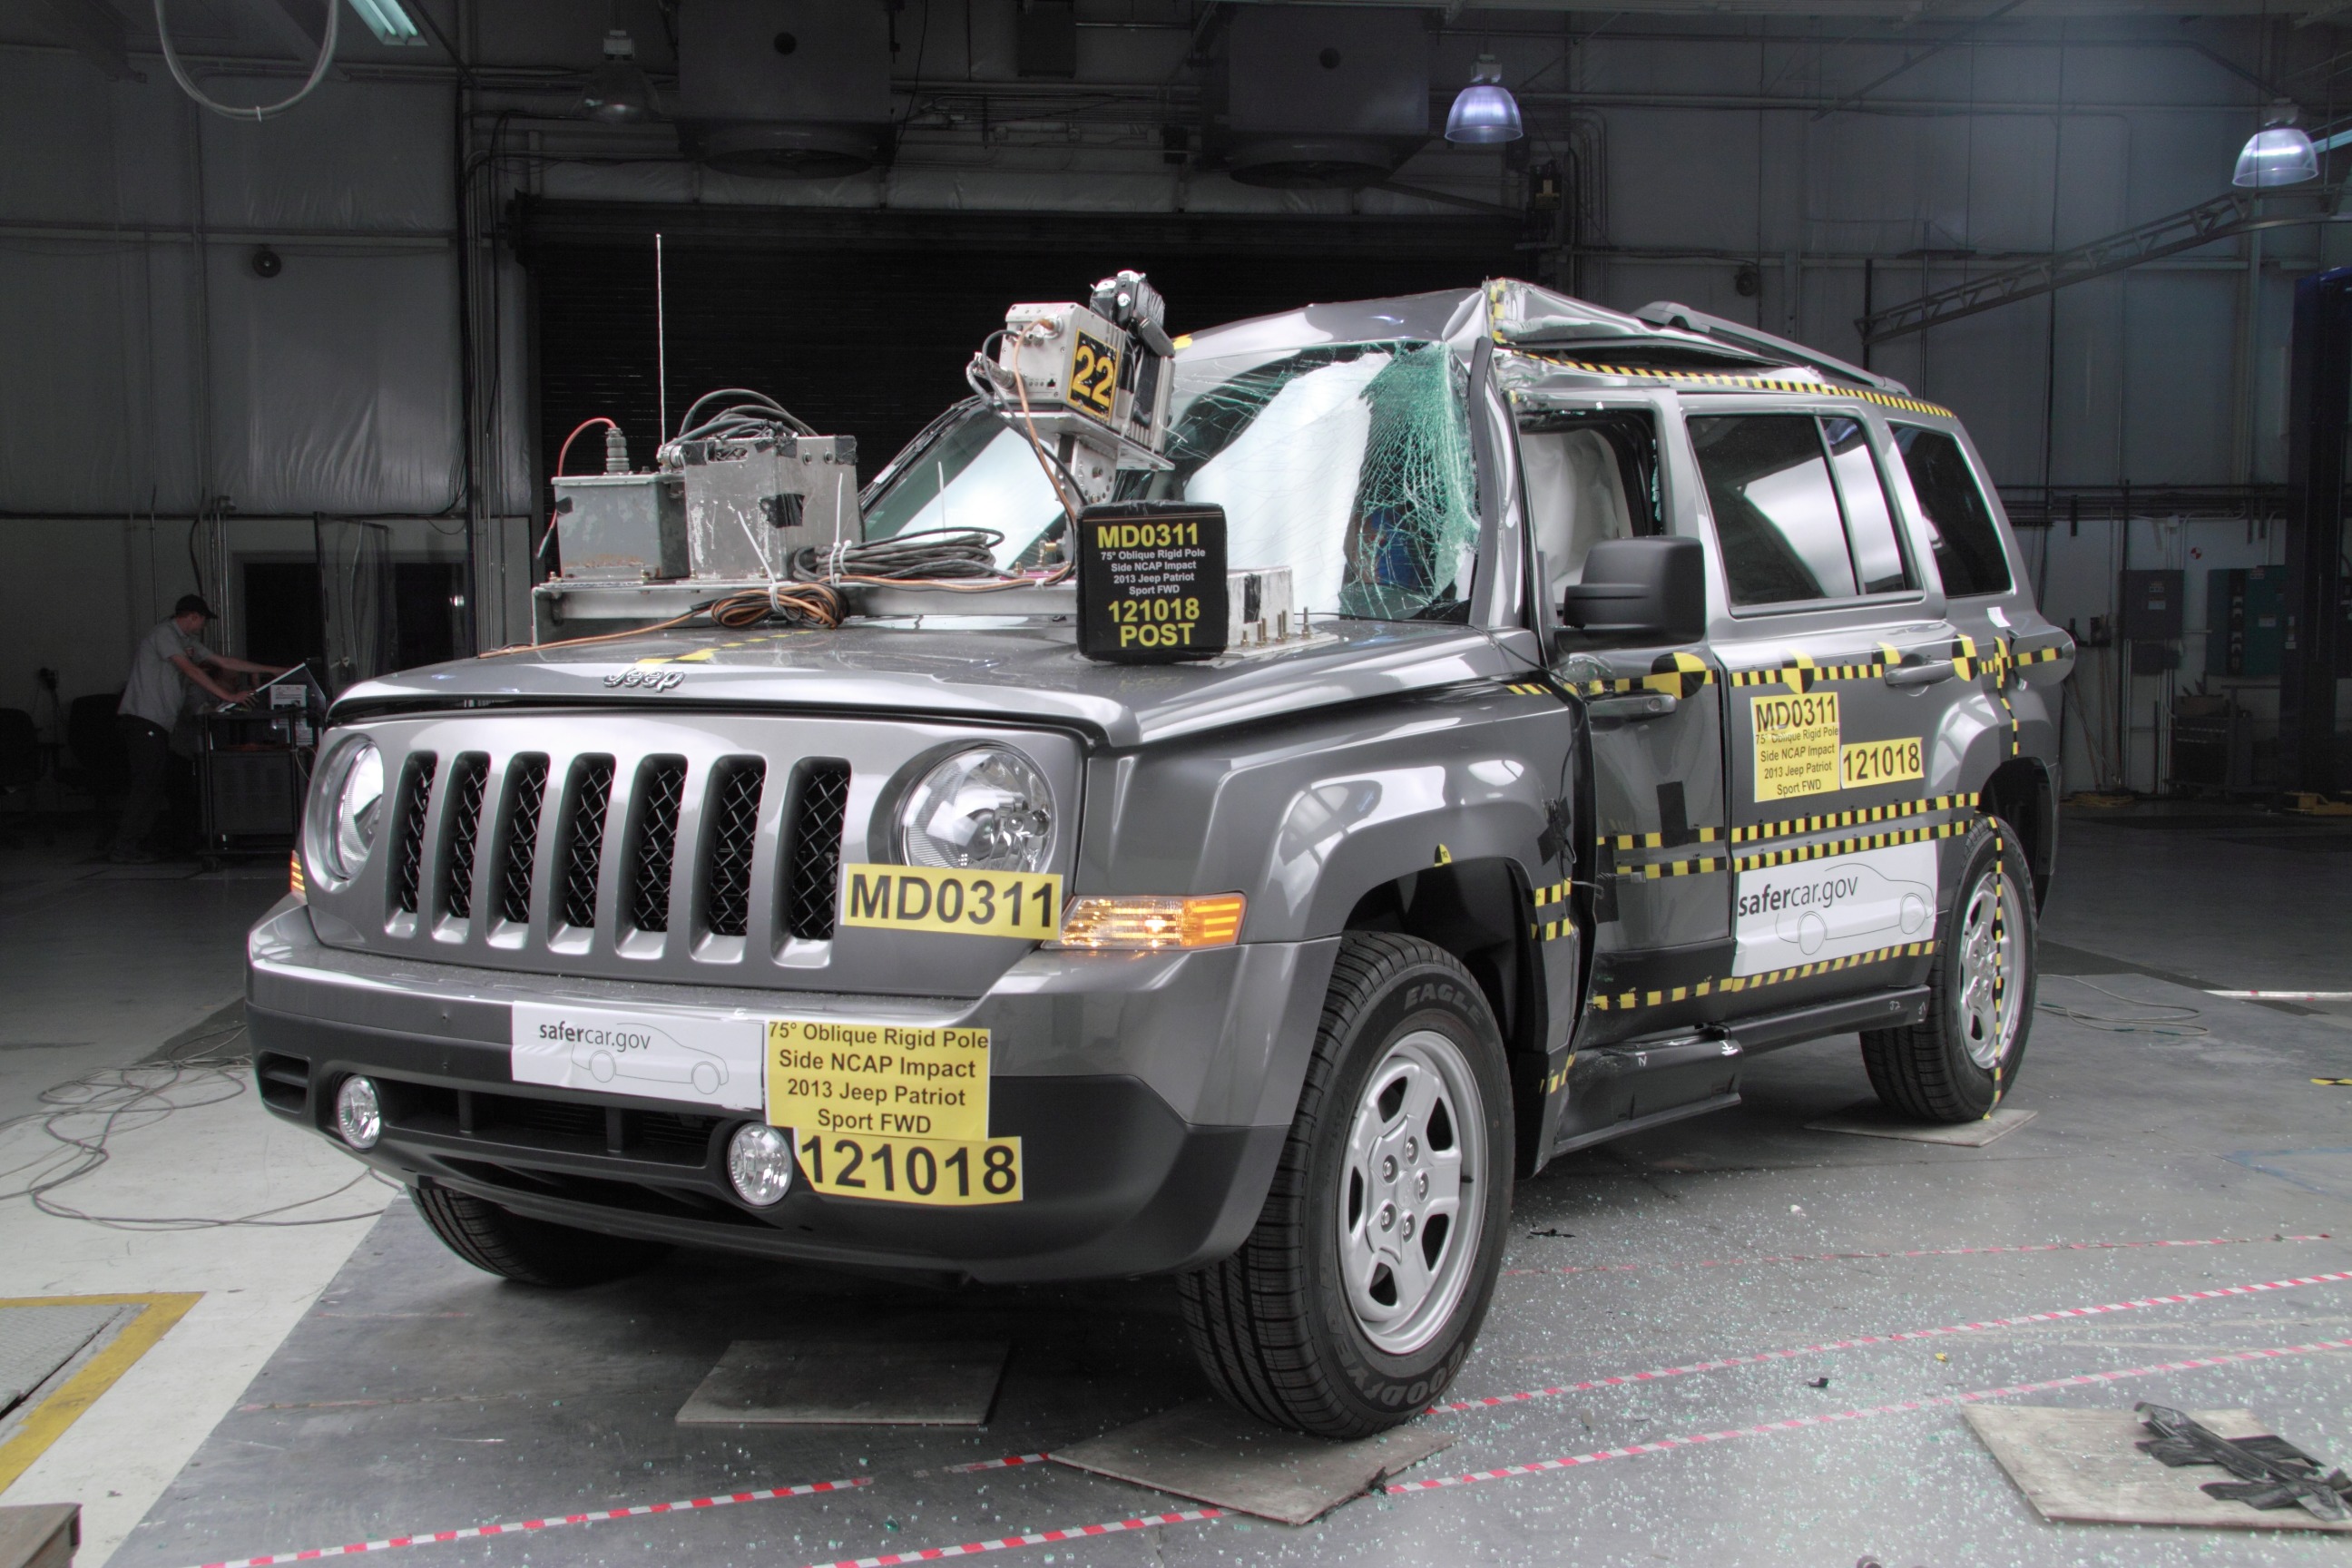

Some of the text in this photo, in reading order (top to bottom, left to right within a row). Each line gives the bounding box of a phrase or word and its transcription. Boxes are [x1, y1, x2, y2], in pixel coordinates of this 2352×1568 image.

[1073, 345, 1114, 407] 22
[1097, 523, 1198, 548] MD0311
[1101, 548, 1206, 561] 75° Oblique Rigid Pole
[1111, 561, 1196, 573] Side NCAP Impact
[1113, 573, 1194, 585] 2013 Jeep Patriot
[1129, 584, 1180, 597] Sport FWD
[1108, 598, 1200, 622] 121018
[1120, 622, 1195, 647] POST
[603, 665, 685, 692] Jeep
[1756, 695, 1835, 732] MD0311
[1771, 732, 1801, 746] Oblique
[1803, 728, 1821, 741] Rigid
[1824, 727, 1838, 737] Pole
[1760, 744, 1835, 762] Side NCAP Impact
[1843, 742, 1920, 781] 121018
[1764, 761, 1832, 779] 2013 Jeep Patriot
[1777, 779, 1821, 798] Sport FWD
[850, 874, 1052, 927] MD0311
[1738, 877, 1858, 917] safercar.gov
[1404, 983, 1484, 1024] EAGLE
[539, 1021, 651, 1053] safercar.gov
[769, 1022, 989, 1050] 75° Oblique Rigid Pole
[779, 1049, 975, 1081] Side NCAP Impact
[788, 1078, 965, 1106] 2013 Jeep Patriot
[818, 1108, 931, 1133] Sport FWD
[801, 1135, 1016, 1196] 121018
